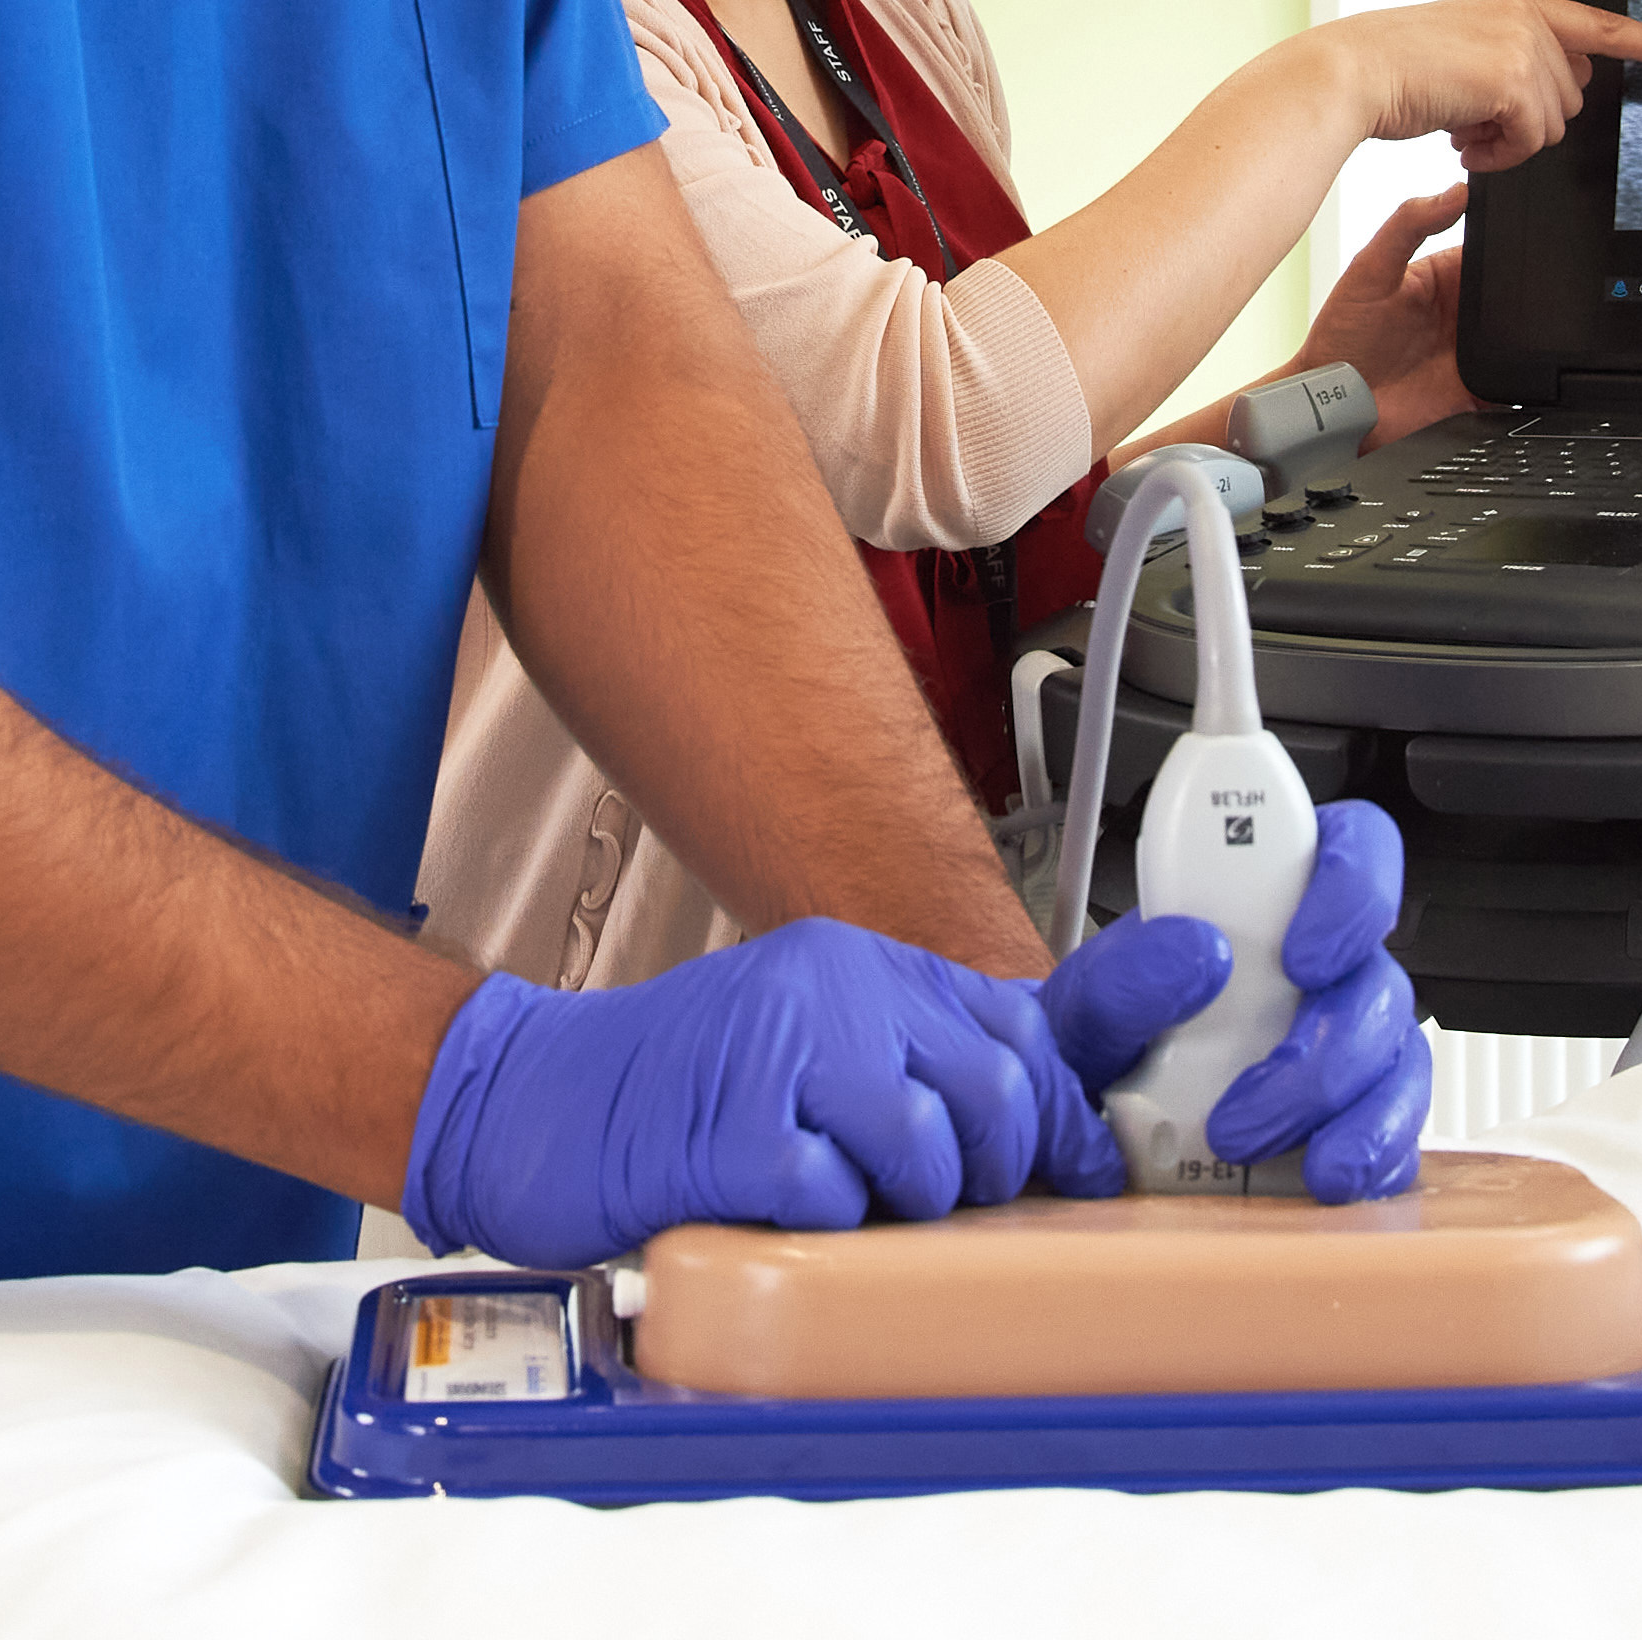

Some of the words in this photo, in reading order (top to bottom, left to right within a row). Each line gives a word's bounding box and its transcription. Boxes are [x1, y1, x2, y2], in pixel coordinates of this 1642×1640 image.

[807, 20, 852, 82] STAFF
[821, 188, 863, 240] STAF
[986, 544, 1007, 589] AFF
[1211, 790, 1265, 808] HFL38
